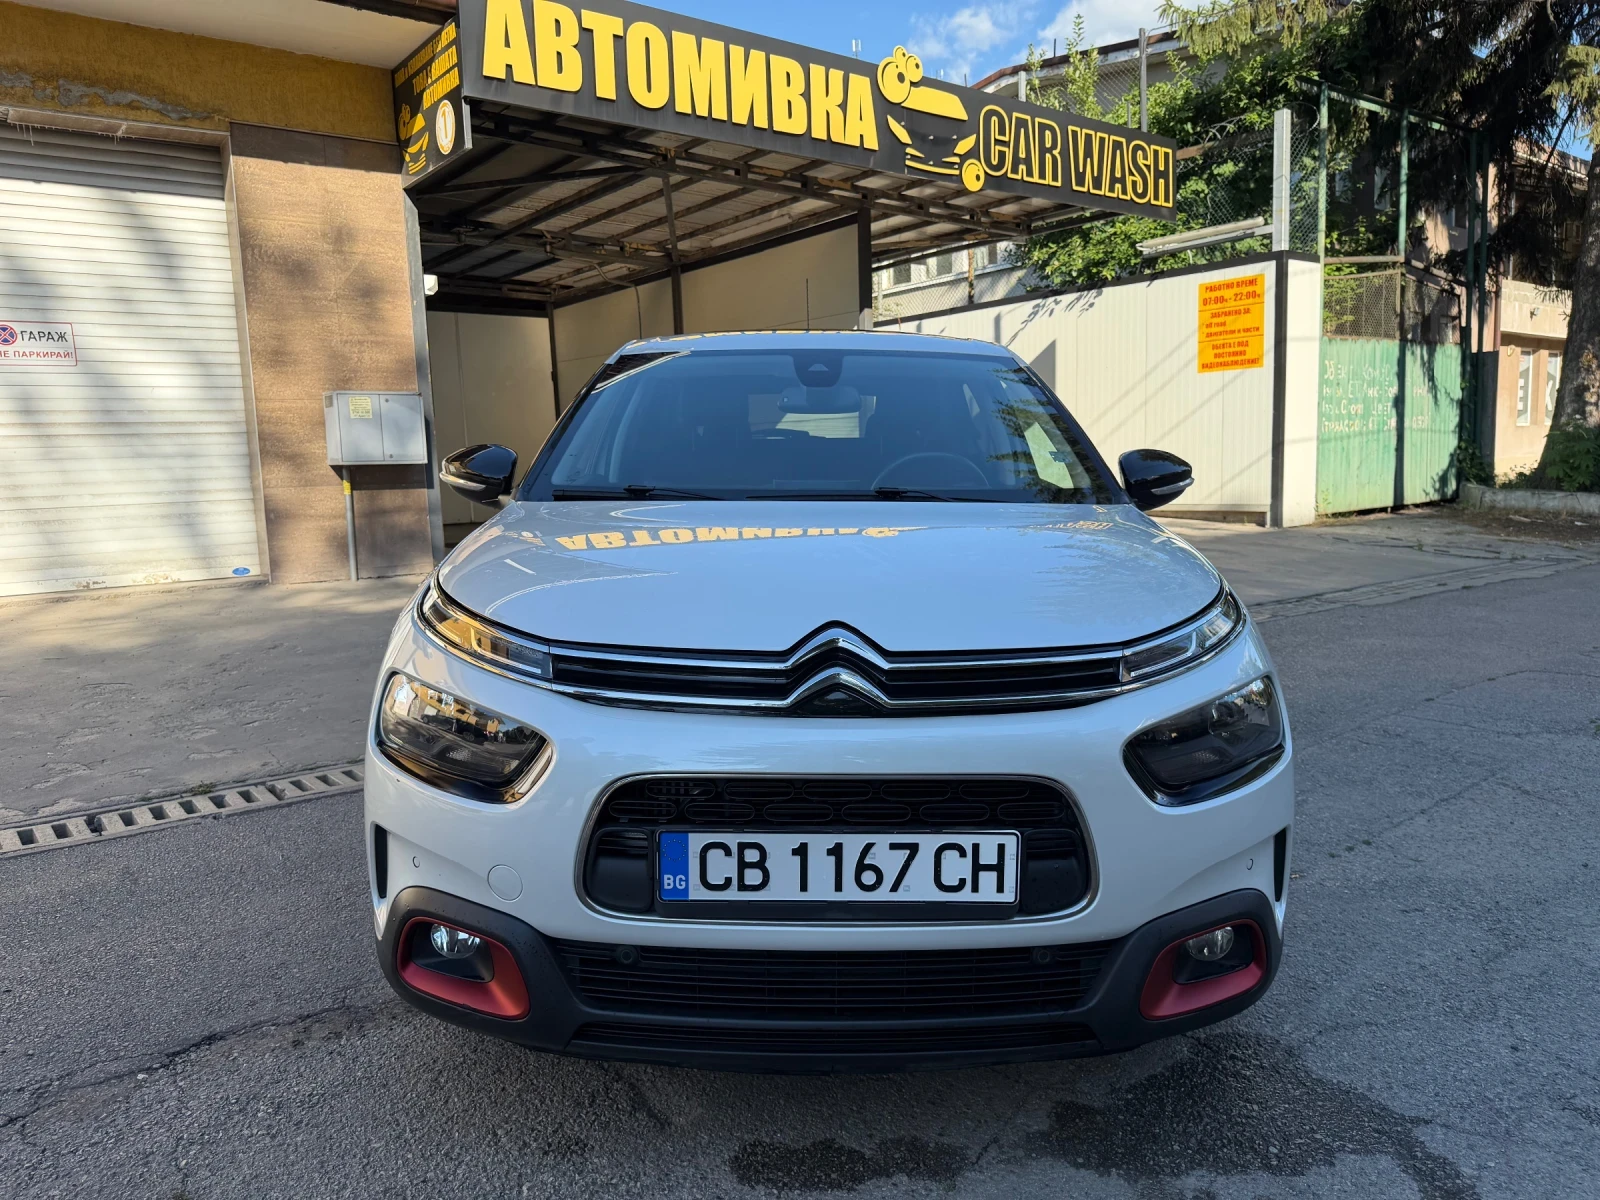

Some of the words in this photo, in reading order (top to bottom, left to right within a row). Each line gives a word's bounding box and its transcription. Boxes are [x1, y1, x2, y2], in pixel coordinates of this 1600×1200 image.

[482, 0, 879, 151] АВТОМИВКА
[423, 66, 460, 110] АВТОМИВКА
[979, 104, 1062, 187] CAR
[1068, 125, 1173, 208] WASH
[1205, 282, 1235, 293] РАБОТНО
[1236, 278, 1259, 289] ВРЕМЕ
[1210, 309, 1242, 319] ЗАБРАНЕНО
[20, 331, 68, 342] ГАРАЖ
[13, 350, 74, 359] ПАРКИРАЙ!
[699, 841, 770, 892] CB
[791, 842, 920, 893] 1167
[934, 842, 1006, 894] CH
[664, 875, 686, 890] BG
